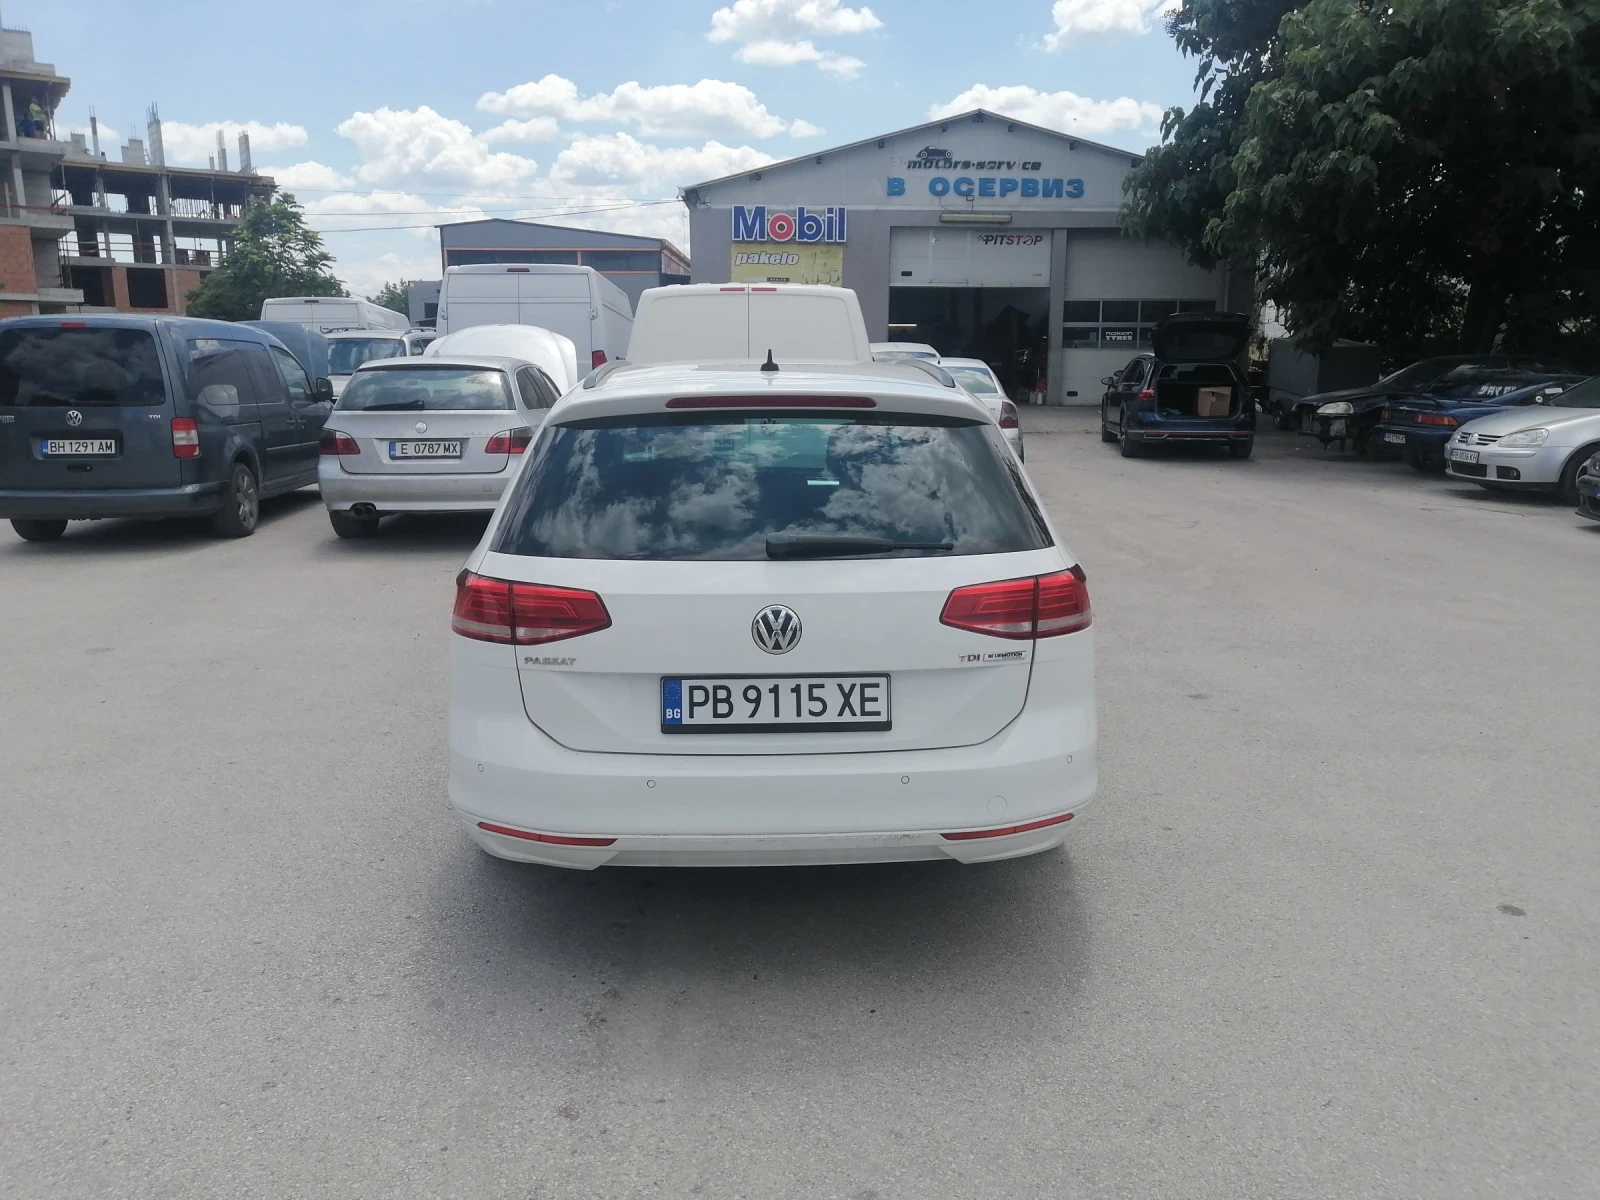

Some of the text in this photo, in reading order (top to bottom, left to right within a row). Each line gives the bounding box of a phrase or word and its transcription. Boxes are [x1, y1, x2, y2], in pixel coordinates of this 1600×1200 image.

[928, 176, 1085, 198] ОСЕРВИЗ
[731, 204, 848, 242] Mobil
[983, 234, 1044, 246] PITSTOP
[735, 251, 800, 266] pakelo
[49, 441, 66, 453] BH
[69, 441, 95, 453] 1291
[97, 441, 114, 453] AM
[400, 443, 409, 455] E
[414, 442, 440, 454] 0787
[443, 442, 459, 454] MX
[524, 657, 577, 666] PASSAT
[959, 653, 981, 662] TDI
[688, 682, 882, 719] PB 9115 XE
[665, 709, 681, 719] BG
